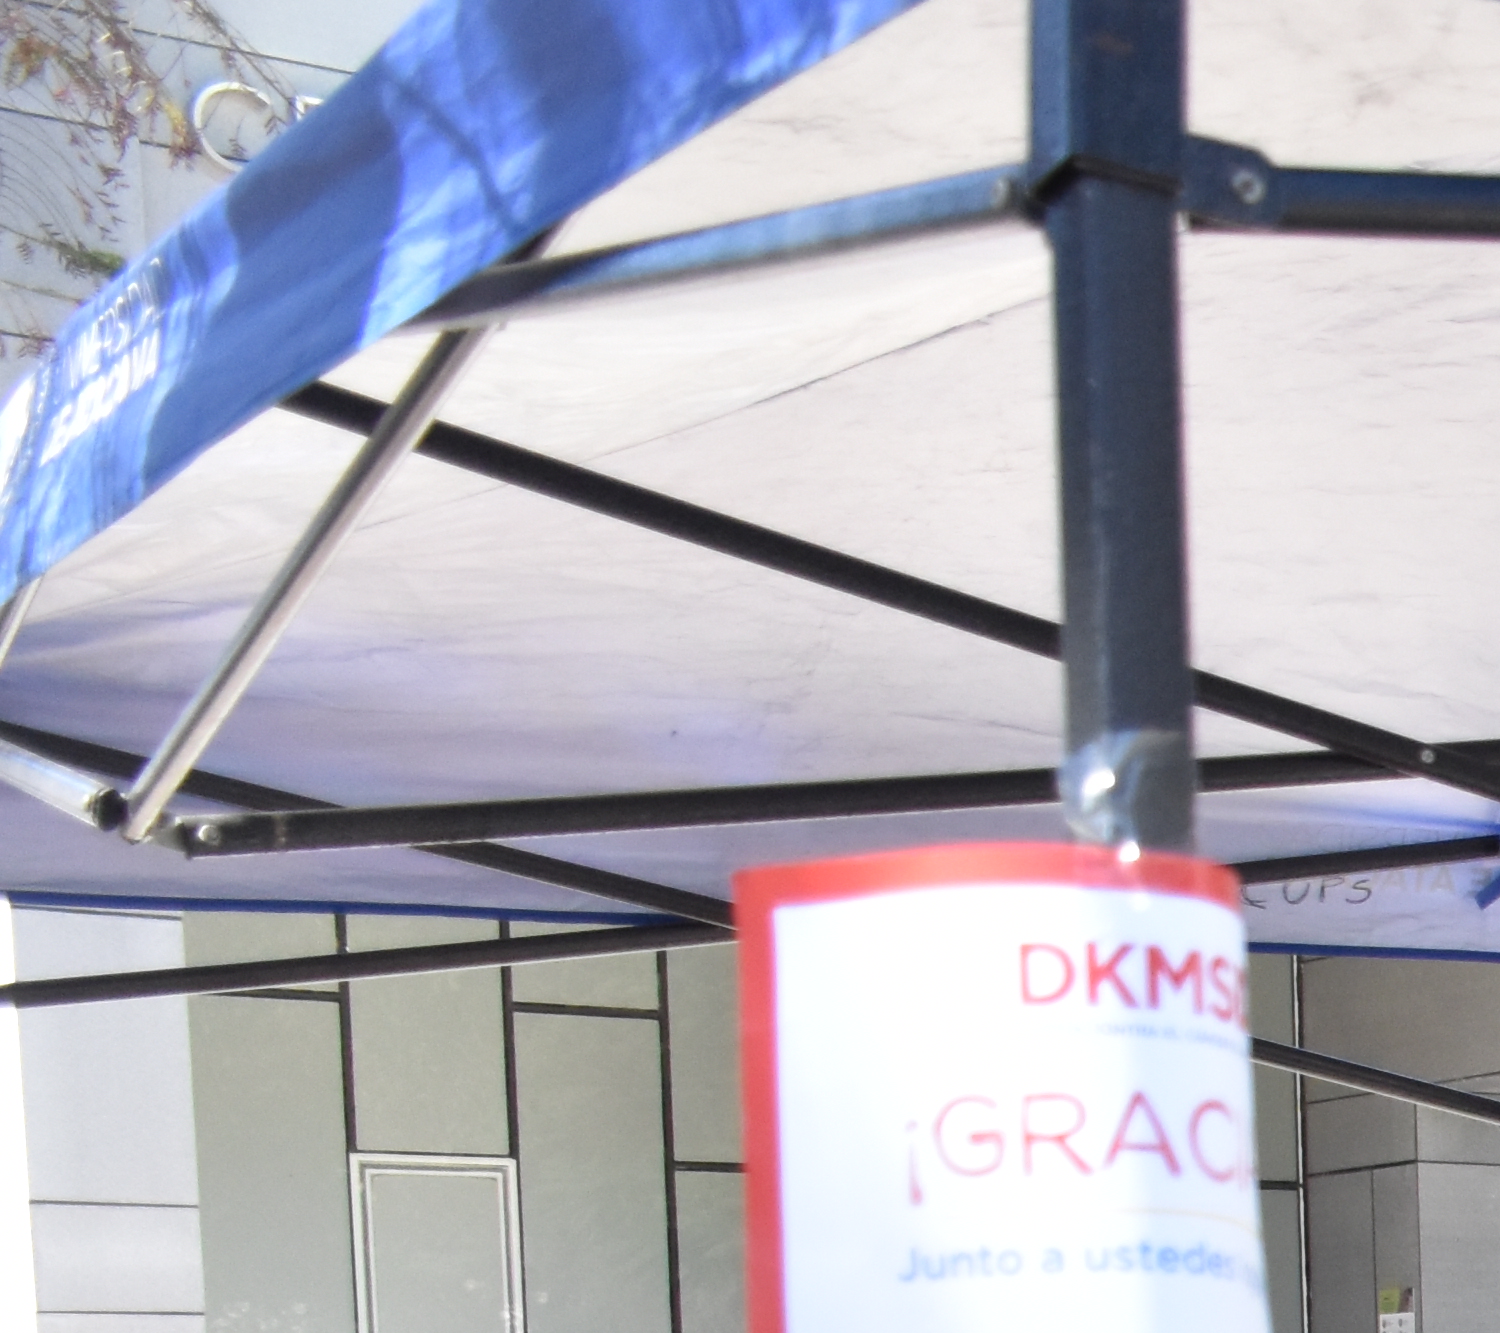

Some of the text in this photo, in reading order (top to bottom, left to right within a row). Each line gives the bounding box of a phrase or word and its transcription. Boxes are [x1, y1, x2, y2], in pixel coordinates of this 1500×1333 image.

[1019, 942, 1236, 1022] DKMS
[899, 1244, 1023, 1282] Junto
[1041, 1246, 1064, 1273] a
